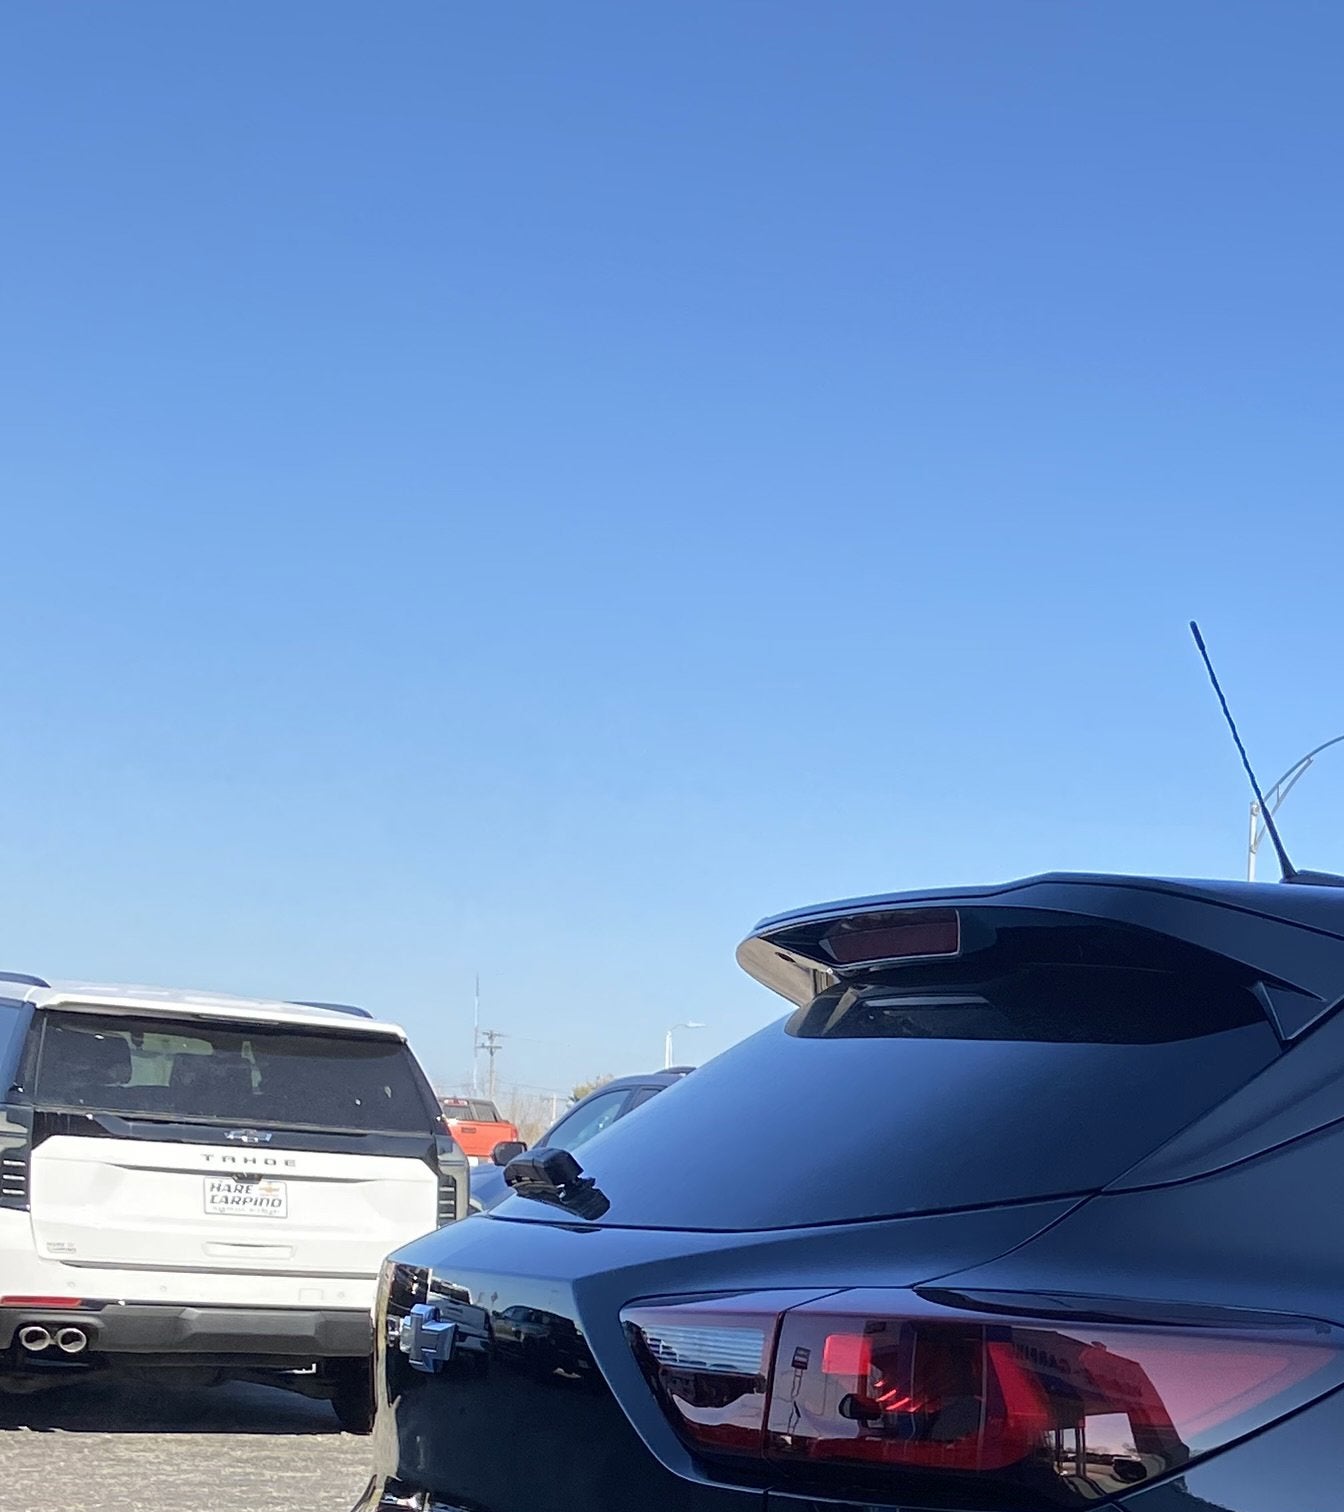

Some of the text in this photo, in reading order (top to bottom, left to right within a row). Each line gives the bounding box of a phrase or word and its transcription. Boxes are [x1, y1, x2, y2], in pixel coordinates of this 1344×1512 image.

[200, 1153, 296, 1167] TAHOE
[209, 1182, 254, 1194] HARE
[209, 1194, 282, 1208] CARPINO
